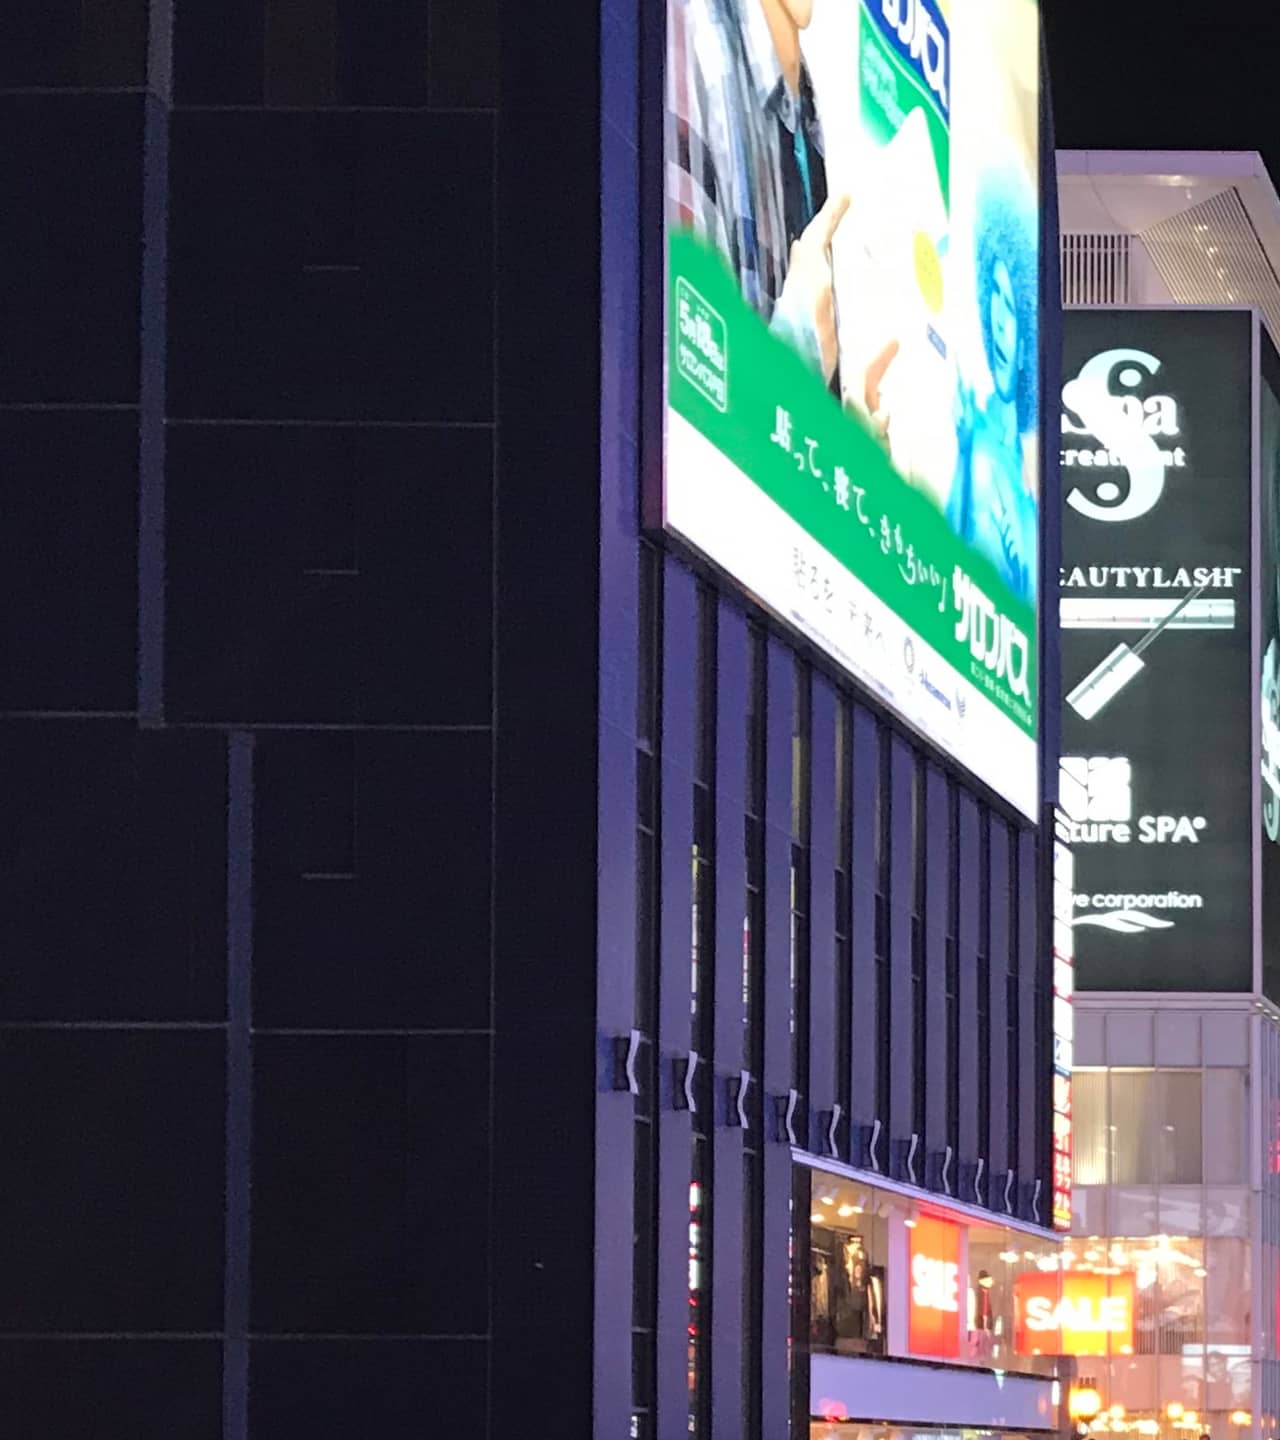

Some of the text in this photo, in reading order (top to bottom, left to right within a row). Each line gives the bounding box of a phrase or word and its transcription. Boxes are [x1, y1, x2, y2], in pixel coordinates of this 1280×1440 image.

[1059, 567, 1237, 588] AUTYLASH
[1091, 890, 1203, 910] corporation
[1025, 1296, 1128, 1331] SALE
